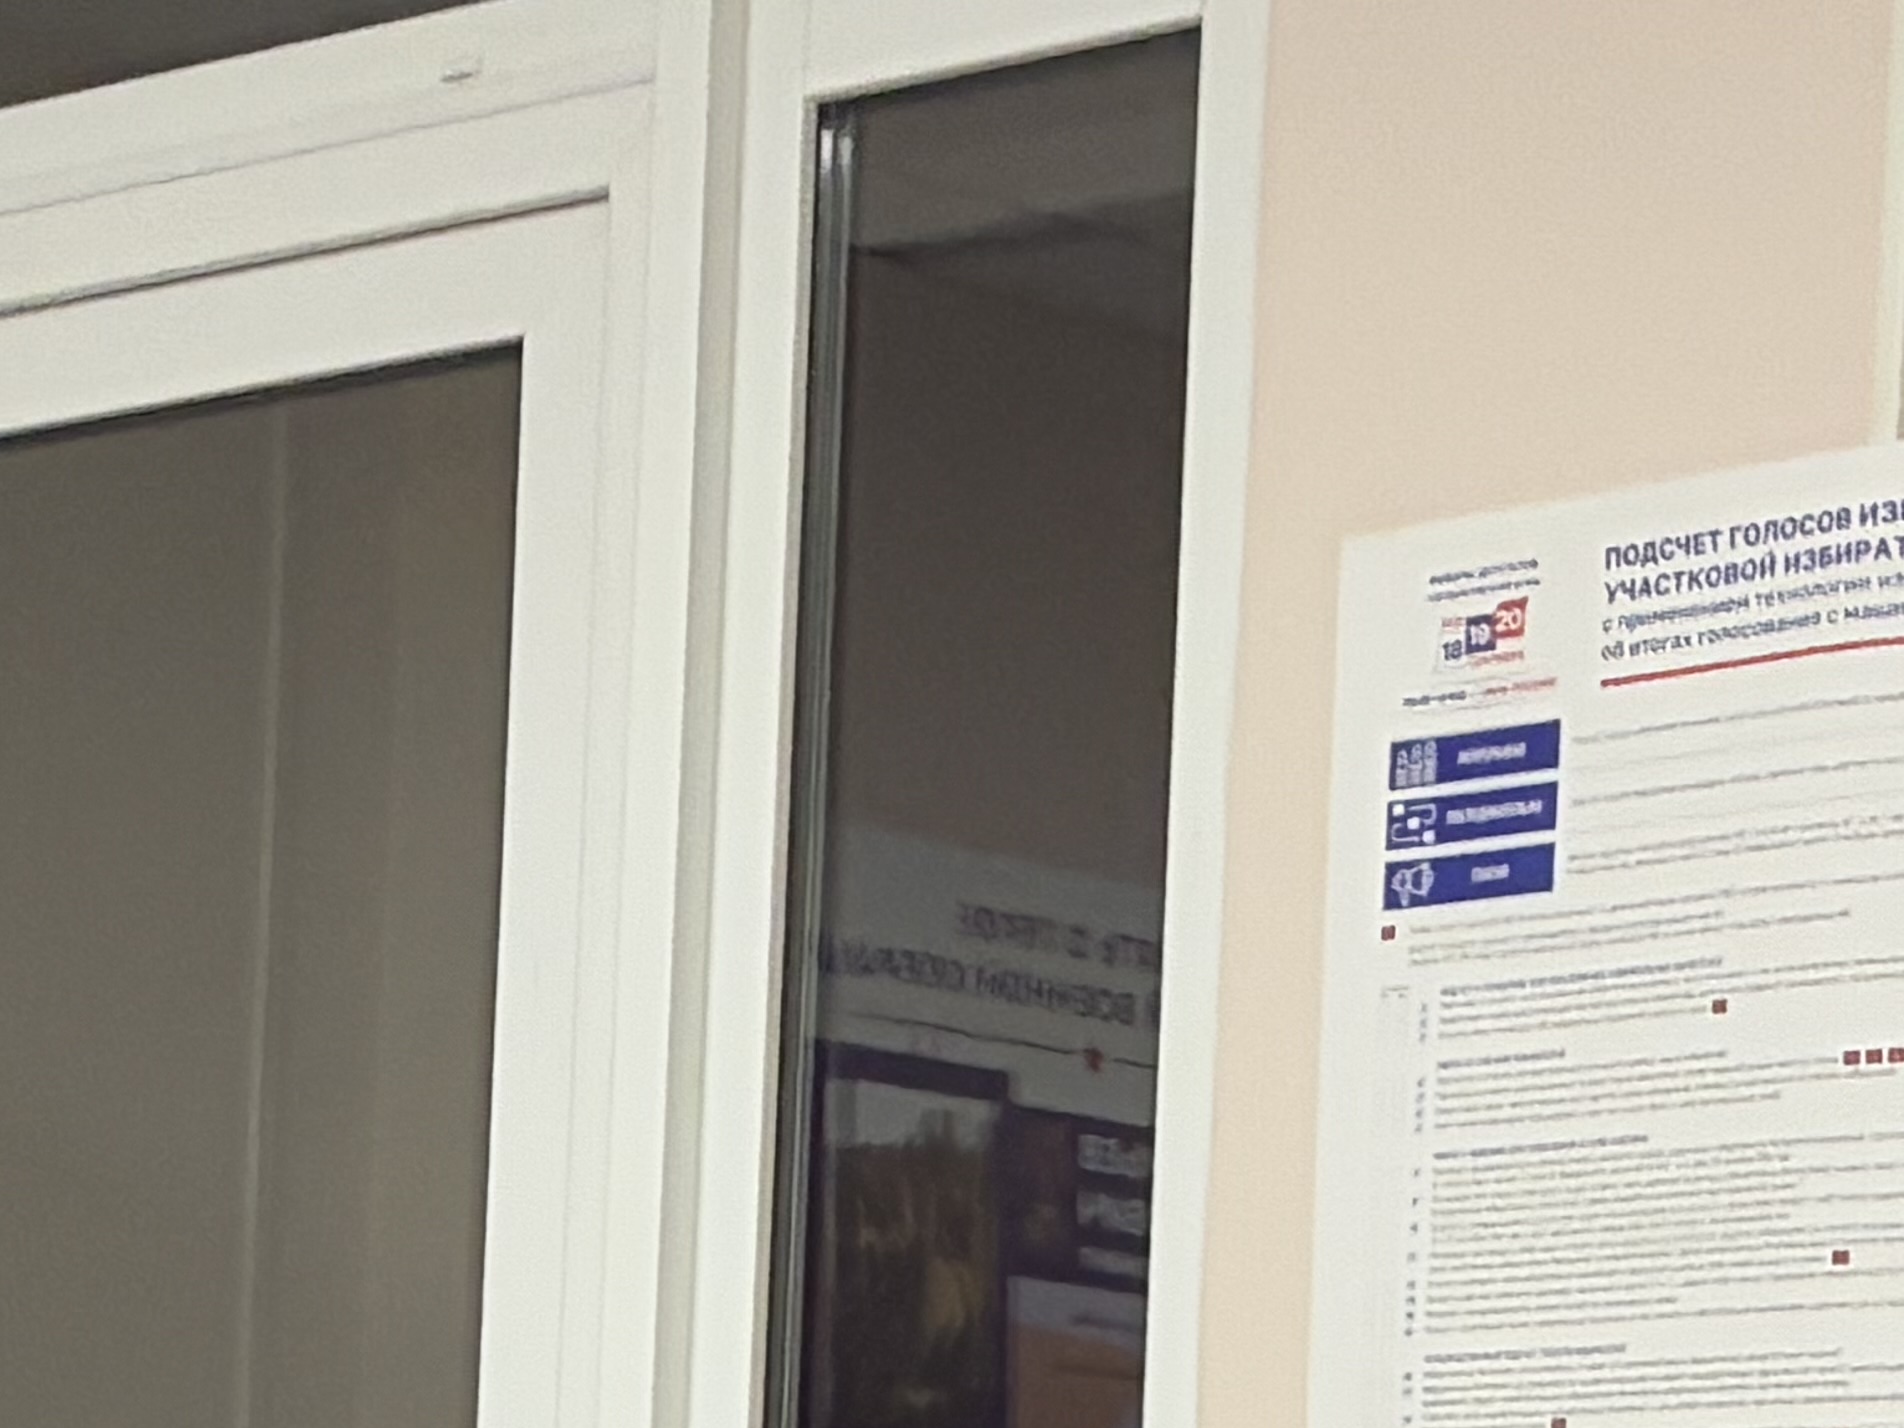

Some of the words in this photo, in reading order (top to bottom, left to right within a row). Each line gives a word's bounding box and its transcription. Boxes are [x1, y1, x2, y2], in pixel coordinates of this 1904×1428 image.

[1604, 530, 1723, 571] ПОДСЧЕТ
[1729, 507, 1852, 550] ГОЛОСОВ
[1859, 498, 1904, 527] ИЗ
[1604, 551, 1776, 605] УЧАСТКОВОЙ
[1495, 607, 1522, 633] 20
